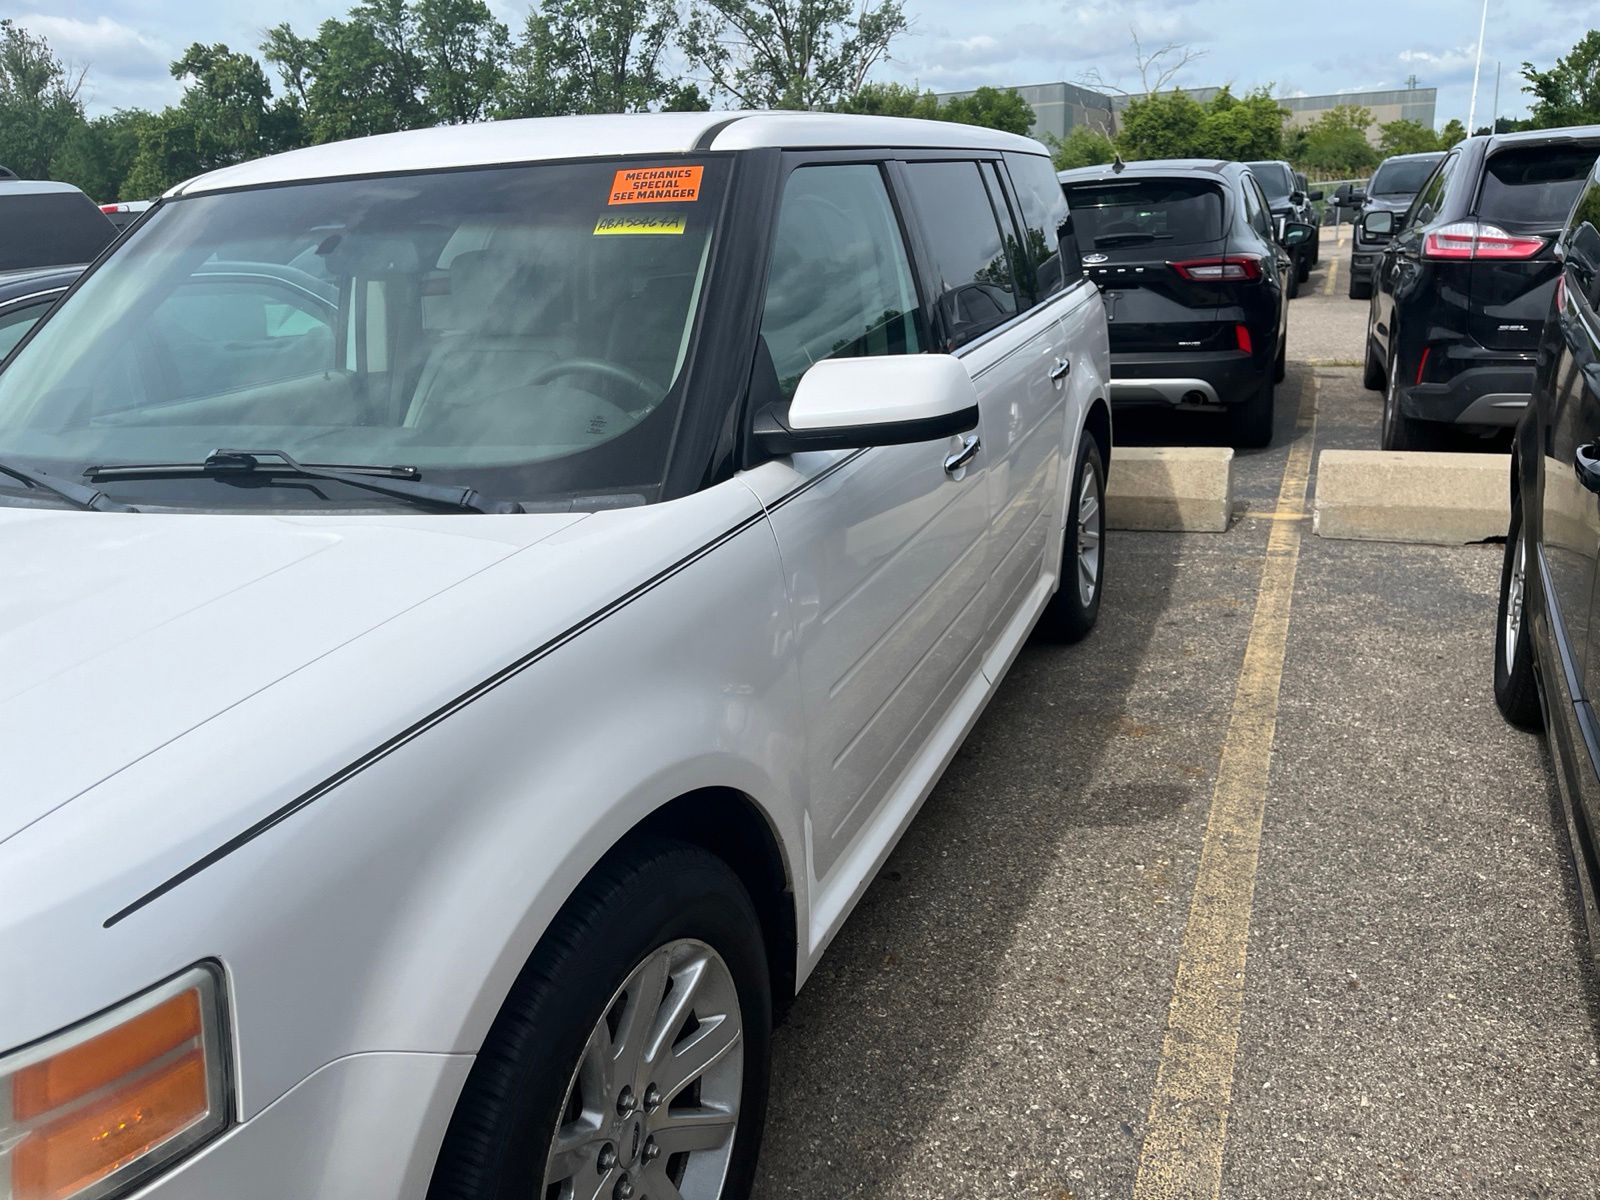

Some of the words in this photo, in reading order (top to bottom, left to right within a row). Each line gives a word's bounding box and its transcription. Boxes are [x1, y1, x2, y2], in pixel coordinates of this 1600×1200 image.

[625, 170, 691, 181] MECHANICS
[632, 180, 679, 190] SPECIAL
[613, 192, 634, 201] SEE
[636, 189, 695, 200] MANAGER
